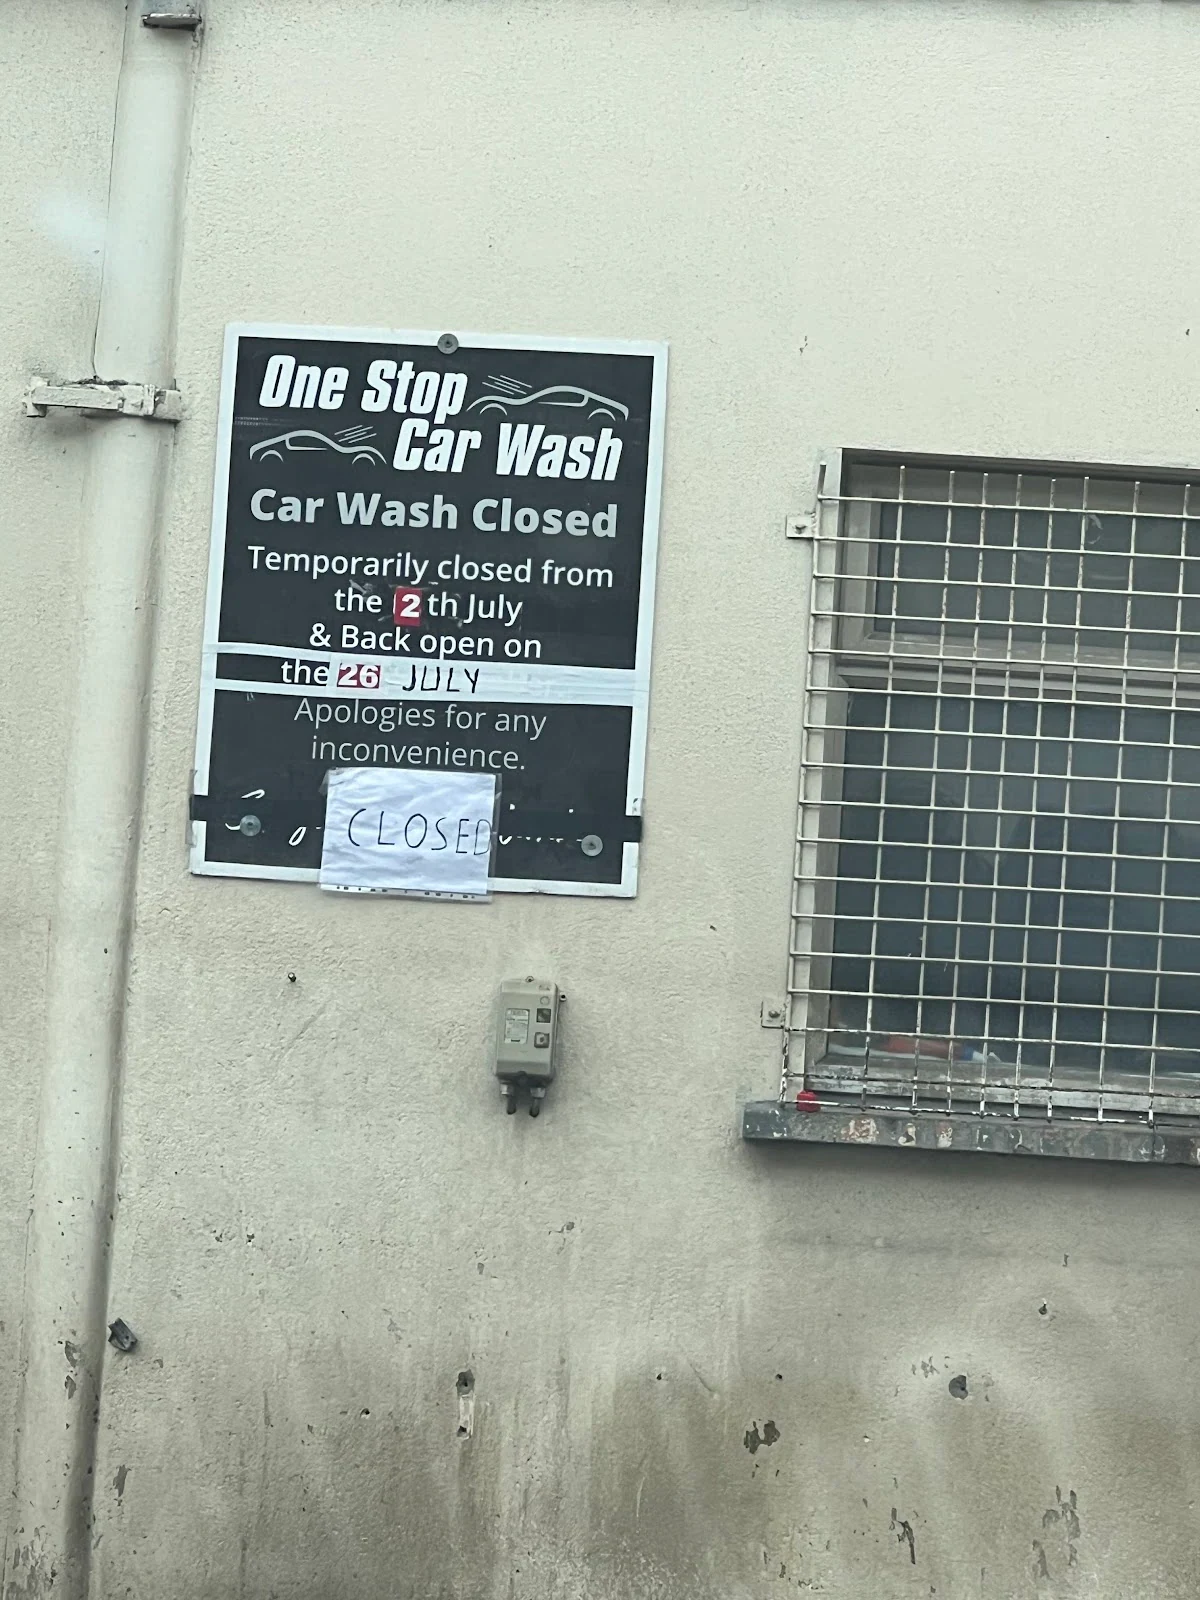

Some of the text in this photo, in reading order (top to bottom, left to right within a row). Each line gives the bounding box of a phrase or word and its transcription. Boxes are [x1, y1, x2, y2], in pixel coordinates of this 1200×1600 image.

[260, 354, 468, 424] One Stop
[393, 419, 623, 481] Car Wash
[250, 489, 616, 537] Car Wash Closed
[248, 546, 613, 587] Temporarily closed from
[335, 588, 382, 613] the
[464, 593, 523, 626] July
[310, 623, 541, 659] & Back open on
[281, 659, 479, 693] the 26 JULY
[294, 698, 546, 740] Apologies for any
[311, 736, 525, 769] inconvenience.
[348, 808, 491, 856] CLOSED
